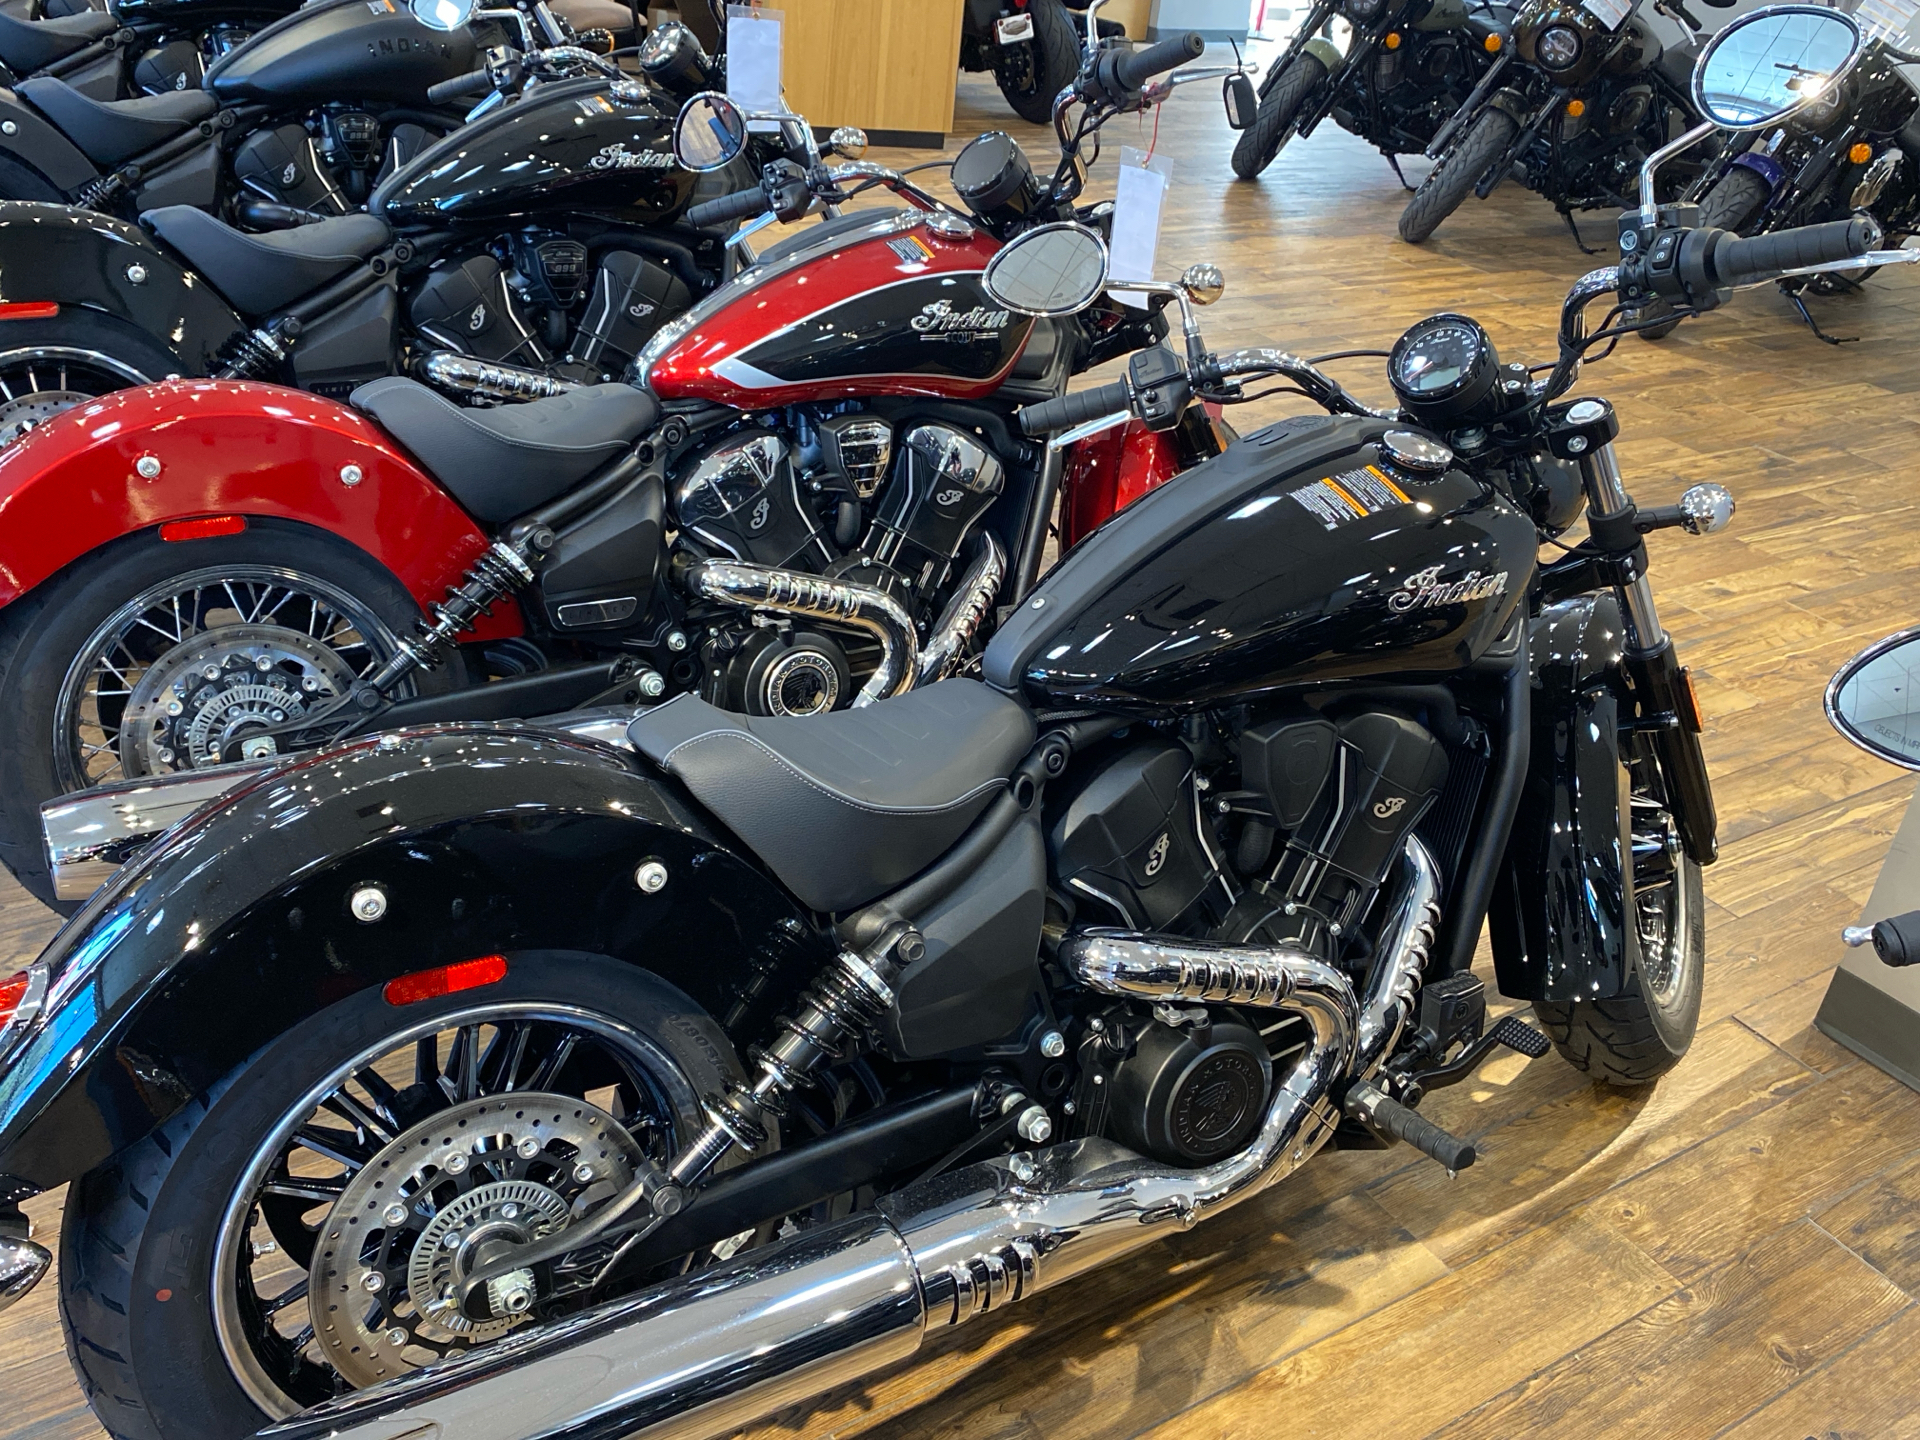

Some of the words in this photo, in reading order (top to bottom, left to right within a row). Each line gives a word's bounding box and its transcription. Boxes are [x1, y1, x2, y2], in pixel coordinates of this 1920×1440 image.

[367, 37, 451, 59] INDIAN
[590, 142, 675, 170] Indian
[910, 299, 1010, 332] Indian
[944, 331, 977, 343] SCOUT
[1388, 563, 1509, 613] Indian
[1874, 724, 1901, 742] OBJECTS
